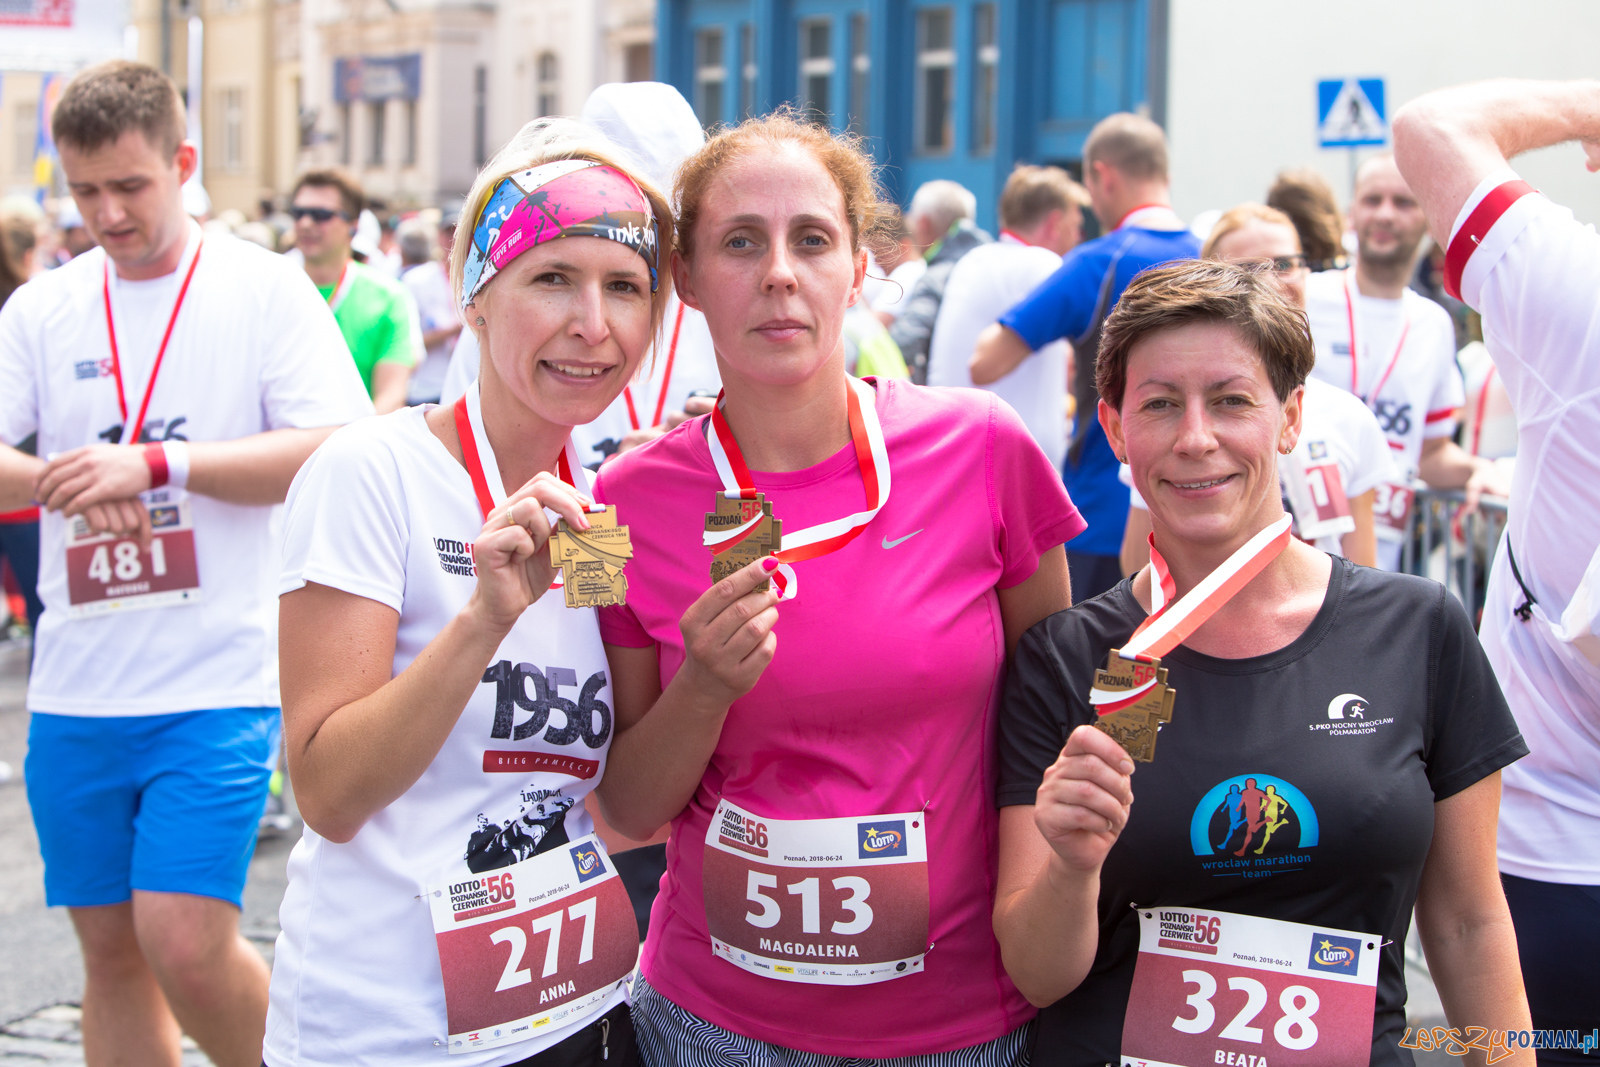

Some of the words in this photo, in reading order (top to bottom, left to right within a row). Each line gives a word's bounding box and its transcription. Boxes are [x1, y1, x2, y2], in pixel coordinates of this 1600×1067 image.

[493, 244, 507, 263] LOVE
[508, 231, 522, 249] RUN
[708, 513, 741, 525] POZNAŃ
[88, 538, 167, 583] 481
[1098, 673, 1133, 688] POZNAŃ
[481, 659, 611, 749] 1956
[1358, 717, 1394, 728] WROCŁAW
[498, 757, 526, 765] BIEG
[535, 757, 590, 773] PAMIĘCI
[724, 808, 742, 824] LOTTO
[720, 826, 745, 842] CZERWIEC
[870, 833, 894, 848] LOTTO
[1202, 859, 1250, 870] wroclaw
[1254, 853, 1311, 866] marathon
[1242, 869, 1272, 879] team
[449, 880, 480, 895] LOTTO
[451, 890, 487, 903] POZNAŃSKI
[452, 897, 489, 911] CZERWIEC
[745, 869, 874, 935] 513
[1160, 911, 1189, 924] LOTTO
[1160, 922, 1194, 933] POZNAŃSKI
[1160, 929, 1193, 941] CZERWIEC
[489, 896, 597, 992] 277
[759, 938, 859, 958] MAGDALENA
[1233, 952, 1258, 962] Poznań,
[1259, 956, 1292, 967] 2018-06-24
[1323, 949, 1347, 962] LOTTO
[539, 980, 576, 1005] ANNA
[1171, 969, 1320, 1050] 328
[1214, 1050, 1268, 1067] BEATA
